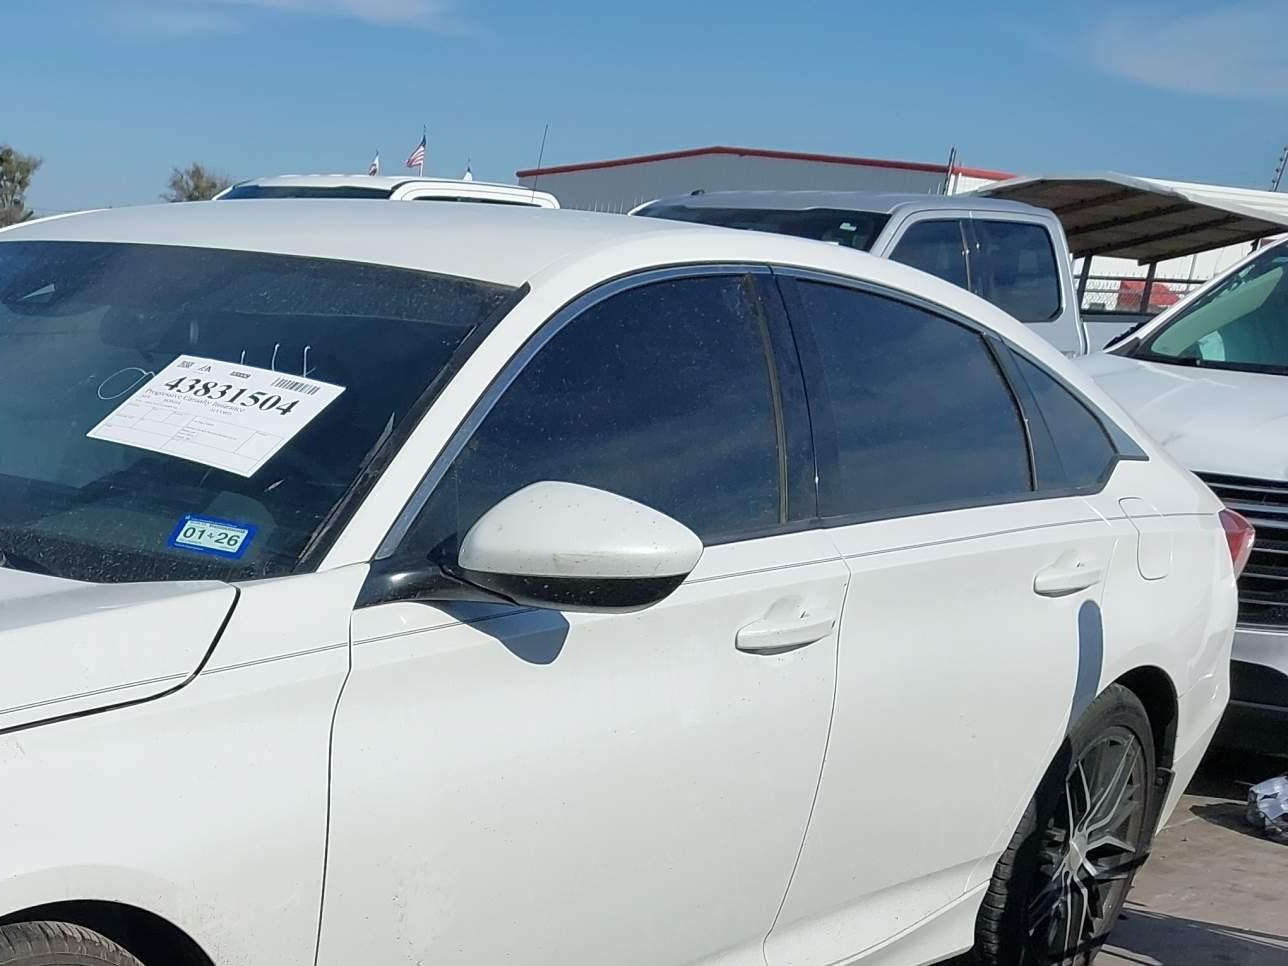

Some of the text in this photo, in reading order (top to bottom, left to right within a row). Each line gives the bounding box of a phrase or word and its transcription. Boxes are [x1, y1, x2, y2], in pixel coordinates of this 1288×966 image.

[165, 376, 300, 416] 43831504
[182, 527, 240, 547] 01 26
